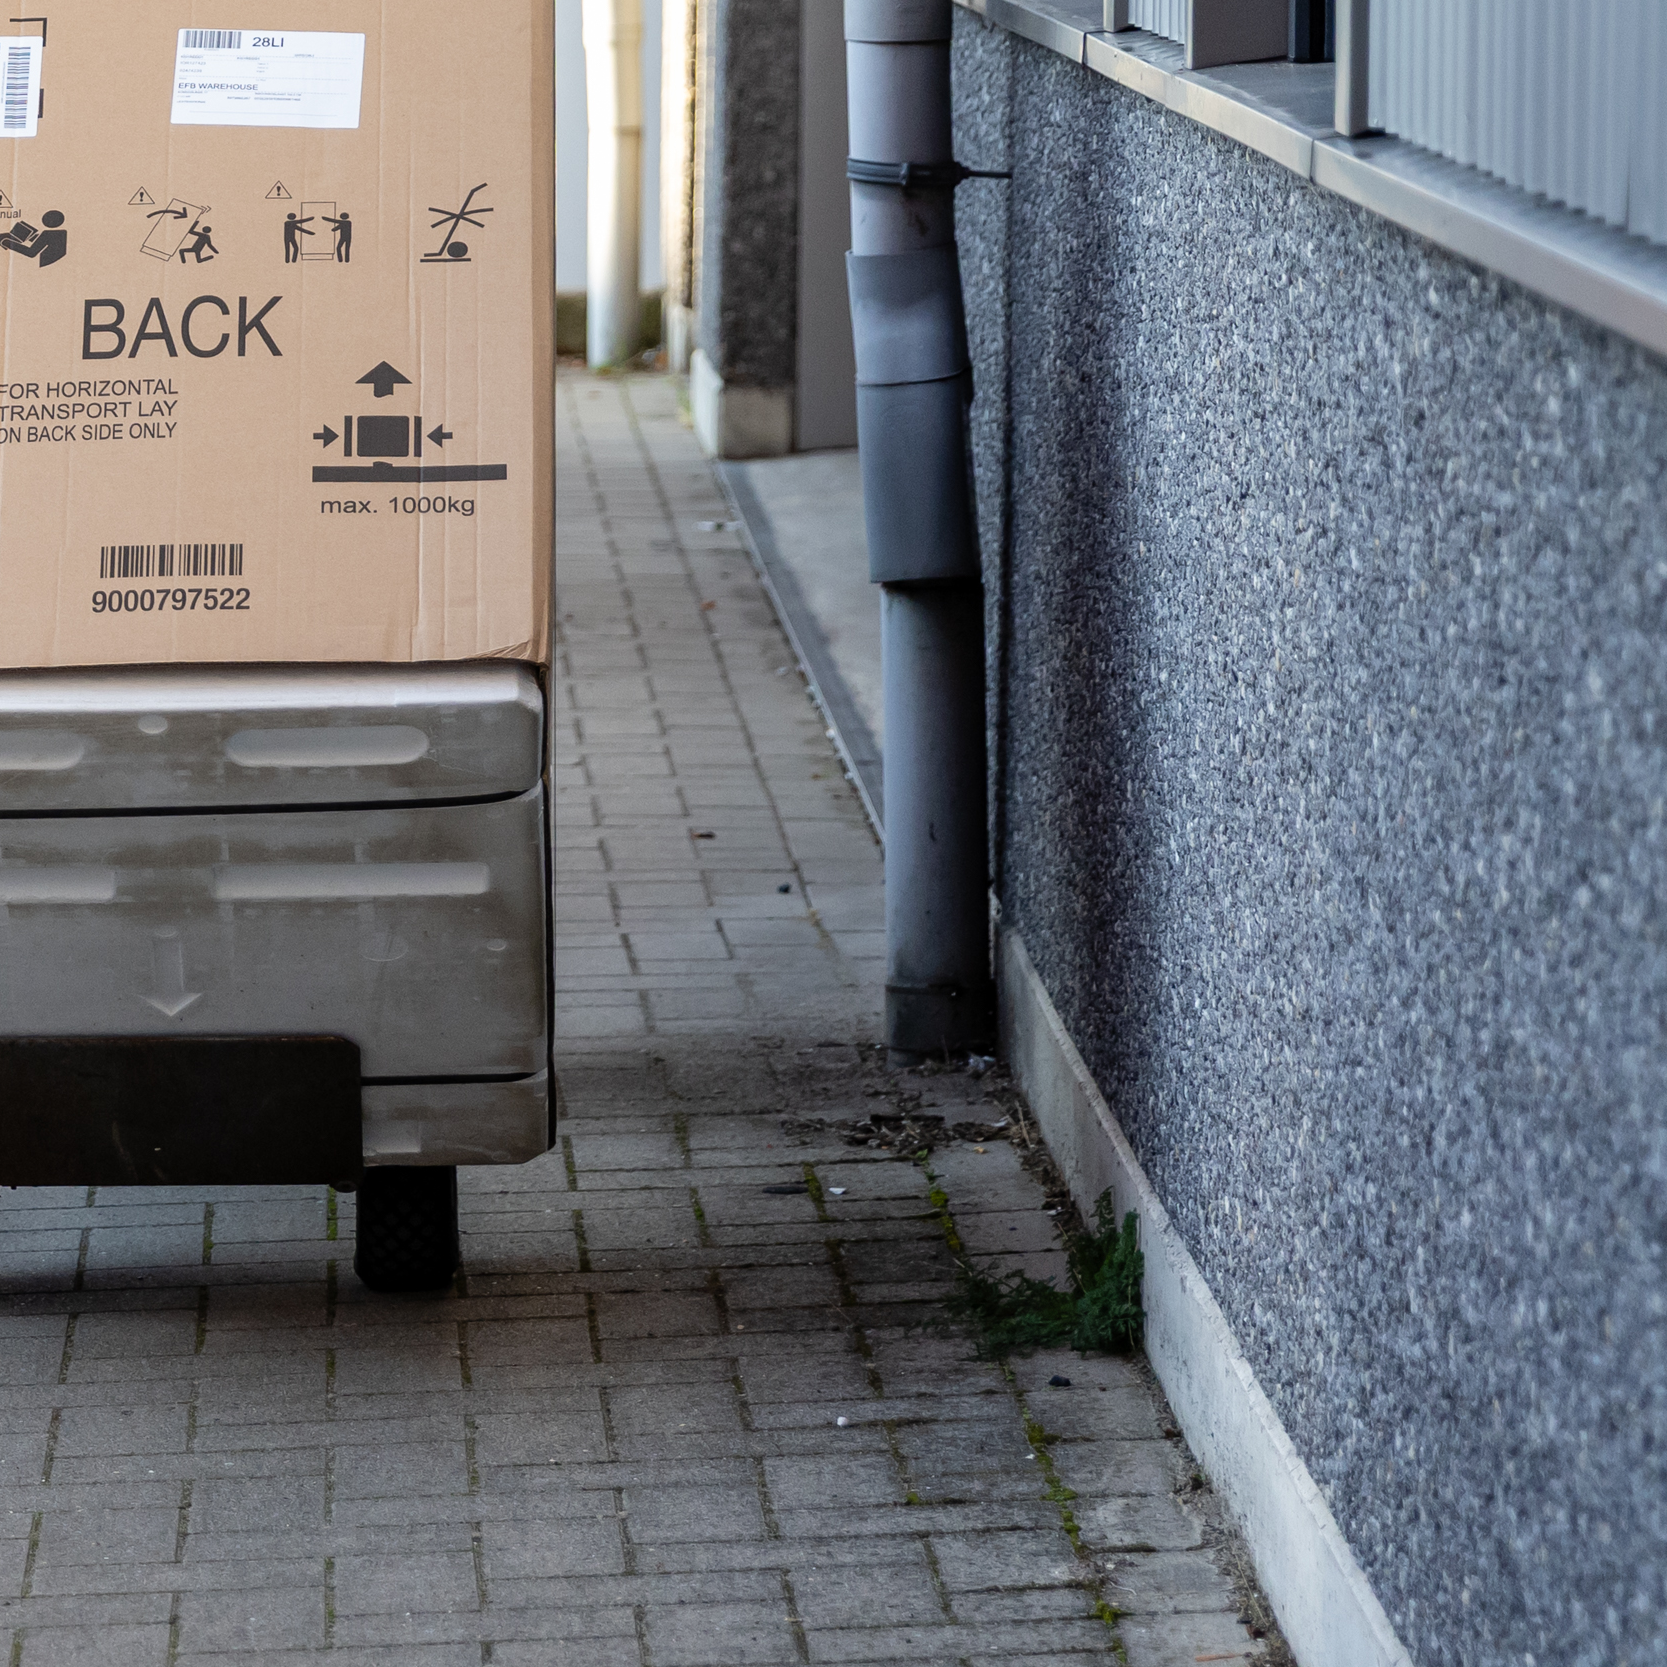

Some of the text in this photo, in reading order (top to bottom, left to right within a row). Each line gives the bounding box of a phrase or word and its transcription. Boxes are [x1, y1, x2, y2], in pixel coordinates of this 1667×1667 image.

[252, 37, 284, 48] 28LI
[198, 83, 259, 91] WAREHOUSE
[81, 295, 284, 360] BACK
[46, 379, 179, 398] HORIZONTAL
[138, 400, 179, 417] LAY
[27, 425, 76, 443] BACK
[81, 424, 123, 441] SIDE
[128, 422, 177, 439] ONLY
[320, 495, 475, 516] max. 1000kg
[91, 588, 251, 613] 9000797522
